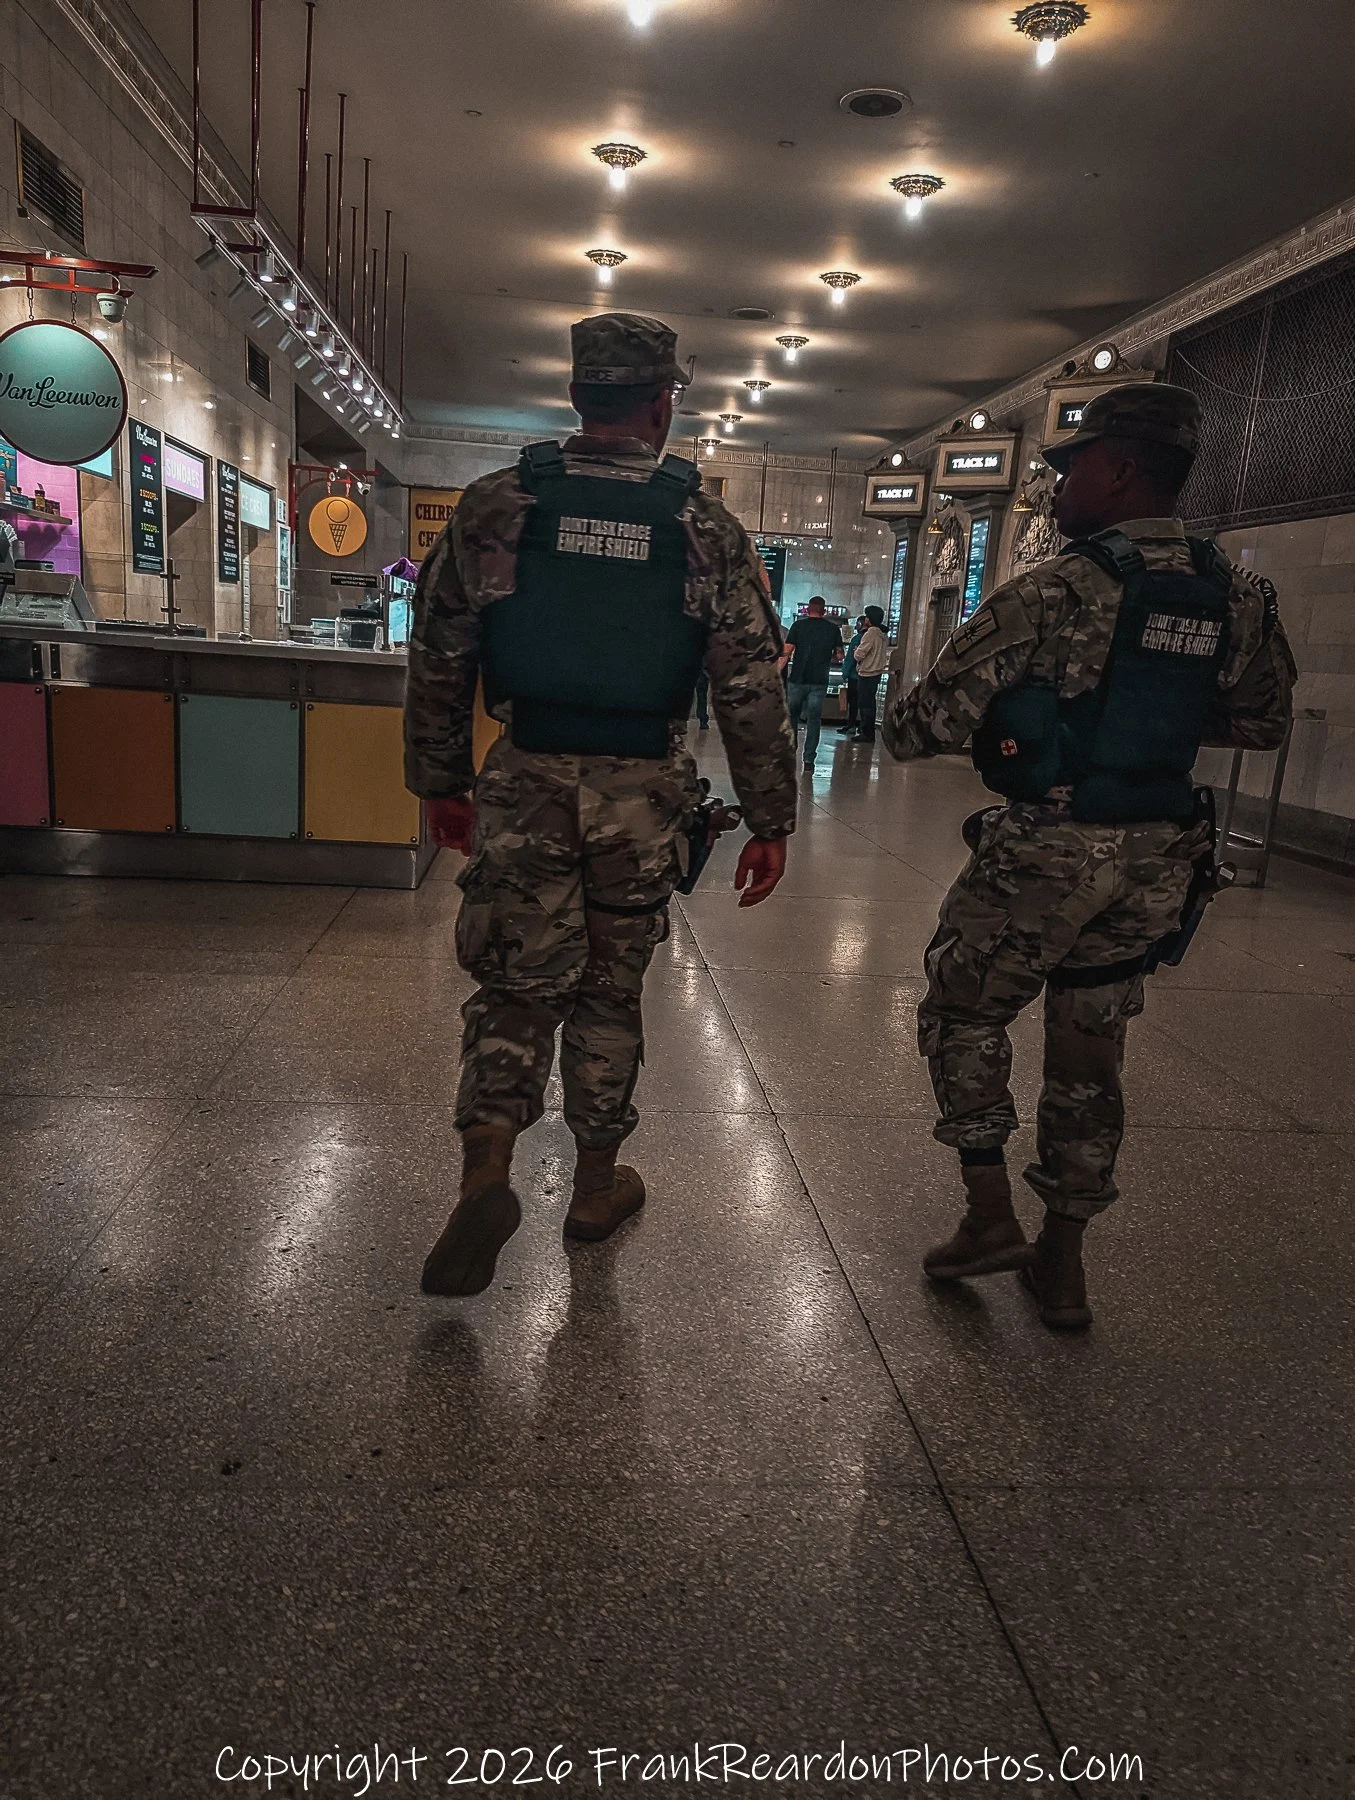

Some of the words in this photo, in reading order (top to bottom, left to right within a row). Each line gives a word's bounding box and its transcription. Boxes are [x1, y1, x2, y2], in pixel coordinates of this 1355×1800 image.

[29, 377, 120, 409] Leeuwen
[166, 458, 200, 489] SUNDAES
[952, 457, 984, 469] TRACK
[877, 489, 902, 499] TRACK
[1141, 628, 1185, 652] EMPIRE
